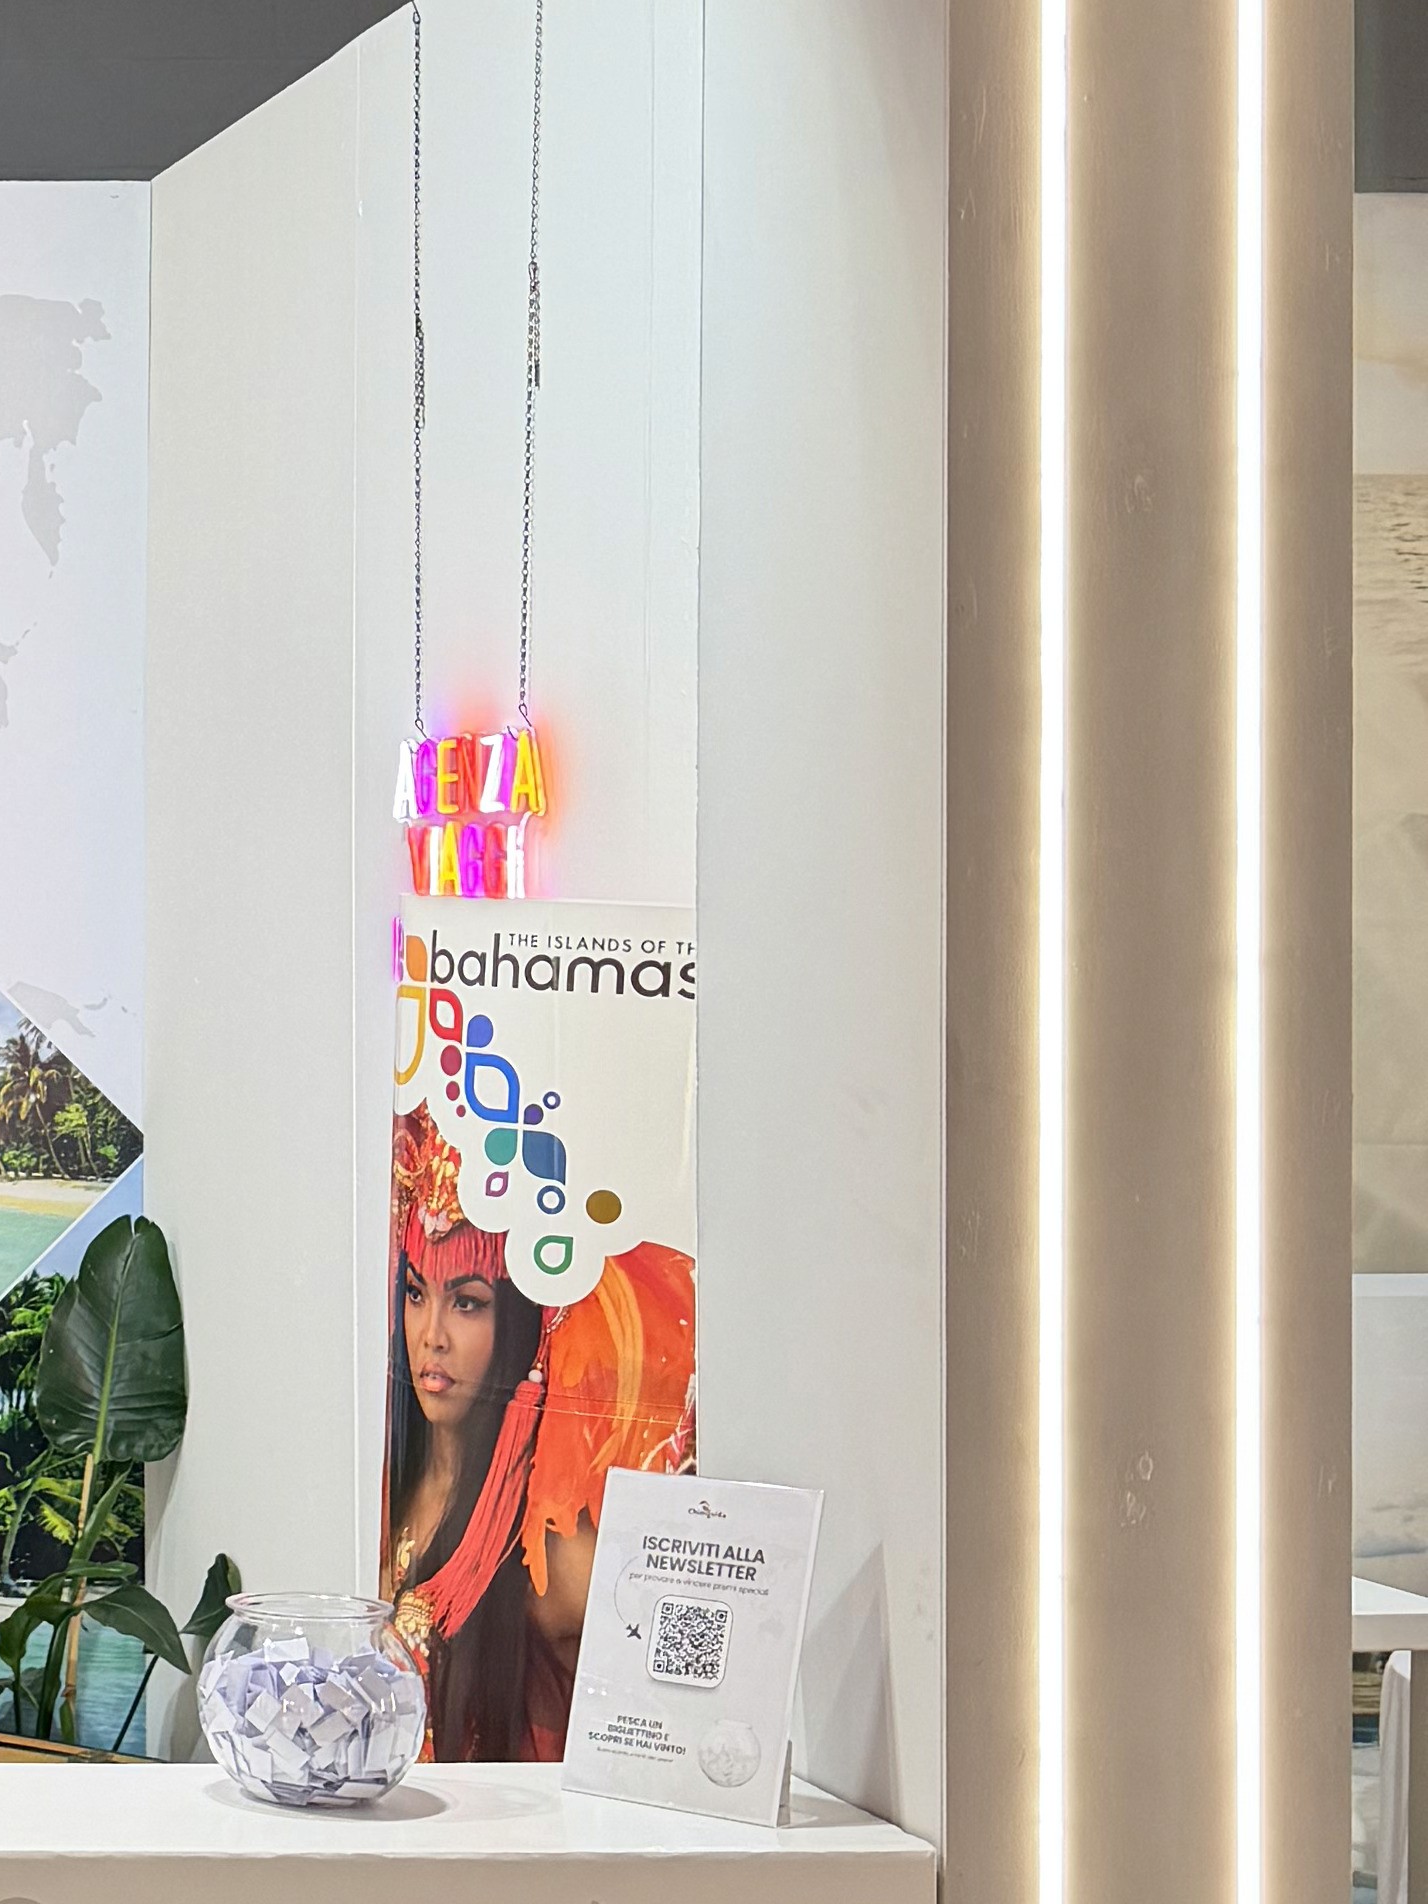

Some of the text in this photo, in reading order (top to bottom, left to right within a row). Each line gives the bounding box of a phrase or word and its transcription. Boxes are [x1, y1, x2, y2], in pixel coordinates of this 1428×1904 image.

[508, 933, 538, 948] THE
[548, 935, 632, 952] ISLANDS
[640, 940, 666, 955] OF
[642, 1536, 765, 1564] ISCRIVITI ALLA
[646, 1554, 757, 1582] NEWSLETTER
